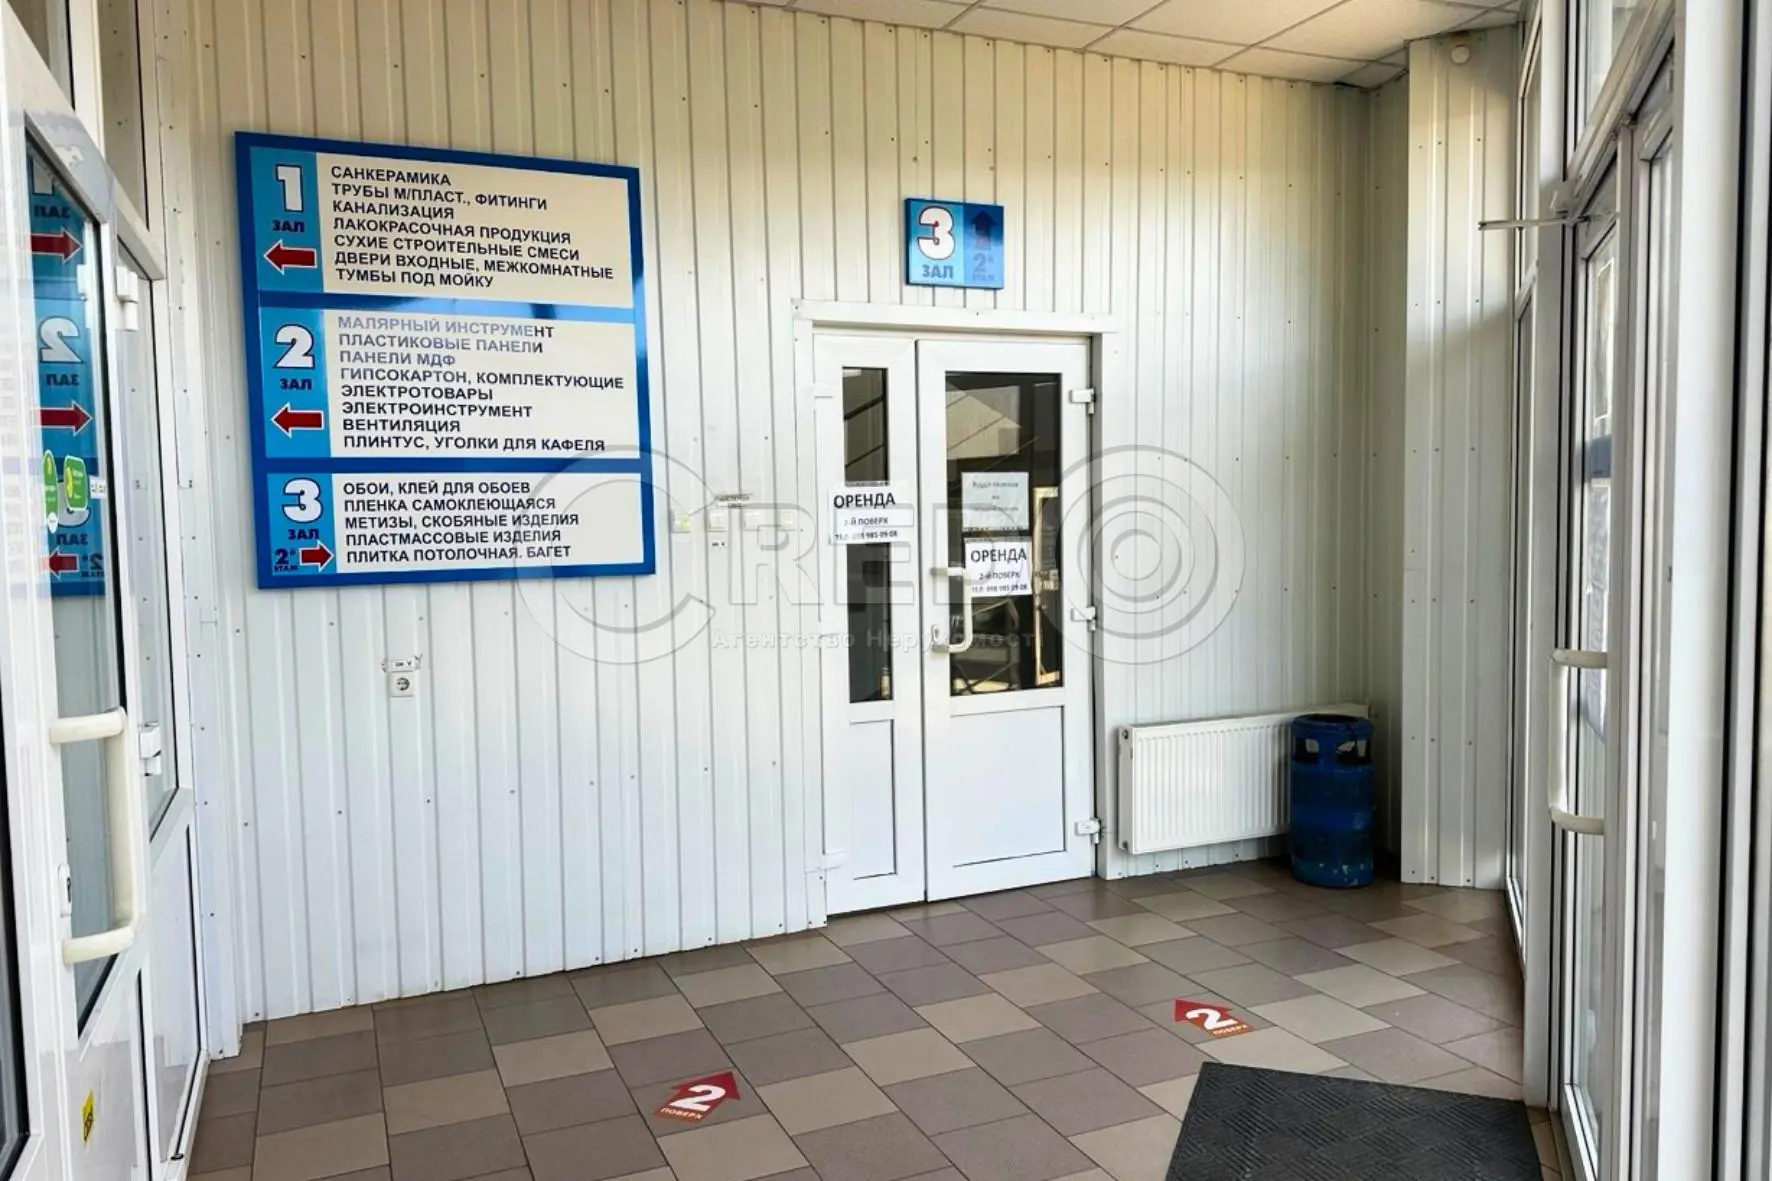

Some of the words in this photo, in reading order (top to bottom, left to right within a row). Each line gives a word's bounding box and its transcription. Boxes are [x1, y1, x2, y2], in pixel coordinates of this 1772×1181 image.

[331, 166, 451, 186] САНКЕРАМИКА
[275, 164, 304, 212] 1
[332, 184, 389, 199] ТРУБЫ
[393, 187, 471, 205] М/ПЛАСТ.,
[475, 193, 547, 210] ФИТИНГИ
[333, 201, 454, 219] КАНАЛИЗАЦИЯ
[272, 220, 304, 233] ЗАЛ
[334, 218, 473, 237] ЛАКОКРАСОЧНАЯ
[480, 227, 570, 244] ПРОДУКЦИЯ
[917, 205, 956, 260] 3
[335, 235, 390, 249] СУХИЕ
[393, 239, 522, 257] СТРОИТЕЛЬНЫЕ
[527, 245, 579, 260] СМЕСИ
[335, 252, 391, 268] ДВЕРИ
[396, 255, 478, 272] ВХОДНЫЕ,
[484, 260, 613, 279] МЕЖКОМНАТНЫЕ
[922, 265, 953, 279] ЗАЛ
[336, 269, 396, 283] ТУМБЫ
[401, 272, 435, 286] ПОД
[440, 271, 494, 288] МОЙКУ
[338, 316, 440, 332] МАЛЯРНЫЙ
[445, 322, 554, 337] ИНСТРУМЕНТ
[273, 324, 315, 368] 2
[339, 334, 471, 350] ПЛАСТИКОВЫЕ
[476, 338, 544, 353] ПАНЕЛИ
[340, 351, 412, 365] ПАНЕЛИ
[417, 353, 456, 367] МДФ
[280, 378, 312, 390] ЗАЛ
[340, 368, 472, 385] ГИПСОКАРТОН,
[477, 373, 624, 389] КОМПЛЕКТУЮЩИЕ
[341, 385, 493, 400] ЭЛЕКТРОТОВАРЫ
[342, 402, 532, 418] ЭЛЕКТРОИНСТРУМЕНТ
[343, 418, 460, 432] ВЕНТИЛЯЦИЯ
[344, 435, 429, 451] ПЛИНТУС,
[435, 436, 498, 450] УГОЛКИ
[503, 438, 536, 452] ДЛЯ
[541, 438, 605, 451] КАФЕЛЯ
[343, 481, 394, 496] ОБОИ,
[398, 480, 438, 494] КЛЕЙ
[442, 481, 473, 495] ДЛЯ
[479, 481, 530, 494] ОБОЕВ
[283, 478, 324, 523] 3
[344, 499, 407, 512] ПЛЕНКА
[412, 498, 555, 512] САМОКЛЕЮЩАЯСЯ
[834, 492, 895, 509] ОРЕНДА
[345, 515, 417, 529] МЕТИЗЫ,
[421, 514, 508, 527] СКОБЯНЫЕ
[512, 514, 579, 527] ИЗДЕЛИЯ
[858, 517, 888, 525] ПОВЕРХ
[288, 528, 319, 540] ЗАЛ
[346, 531, 489, 545] ПЛАСТМАССОВЫЕ
[494, 530, 560, 544] ИЗДЕЛИЯ
[347, 548, 409, 562] ПЛИТКА
[527, 545, 571, 558] БАГЕТ
[971, 548, 1027, 563] ОРЕНДА
[1186, 1008, 1238, 1030] 2
[669, 1084, 726, 1111] 2
[660, 1108, 703, 1120] ПОВЕРХ
